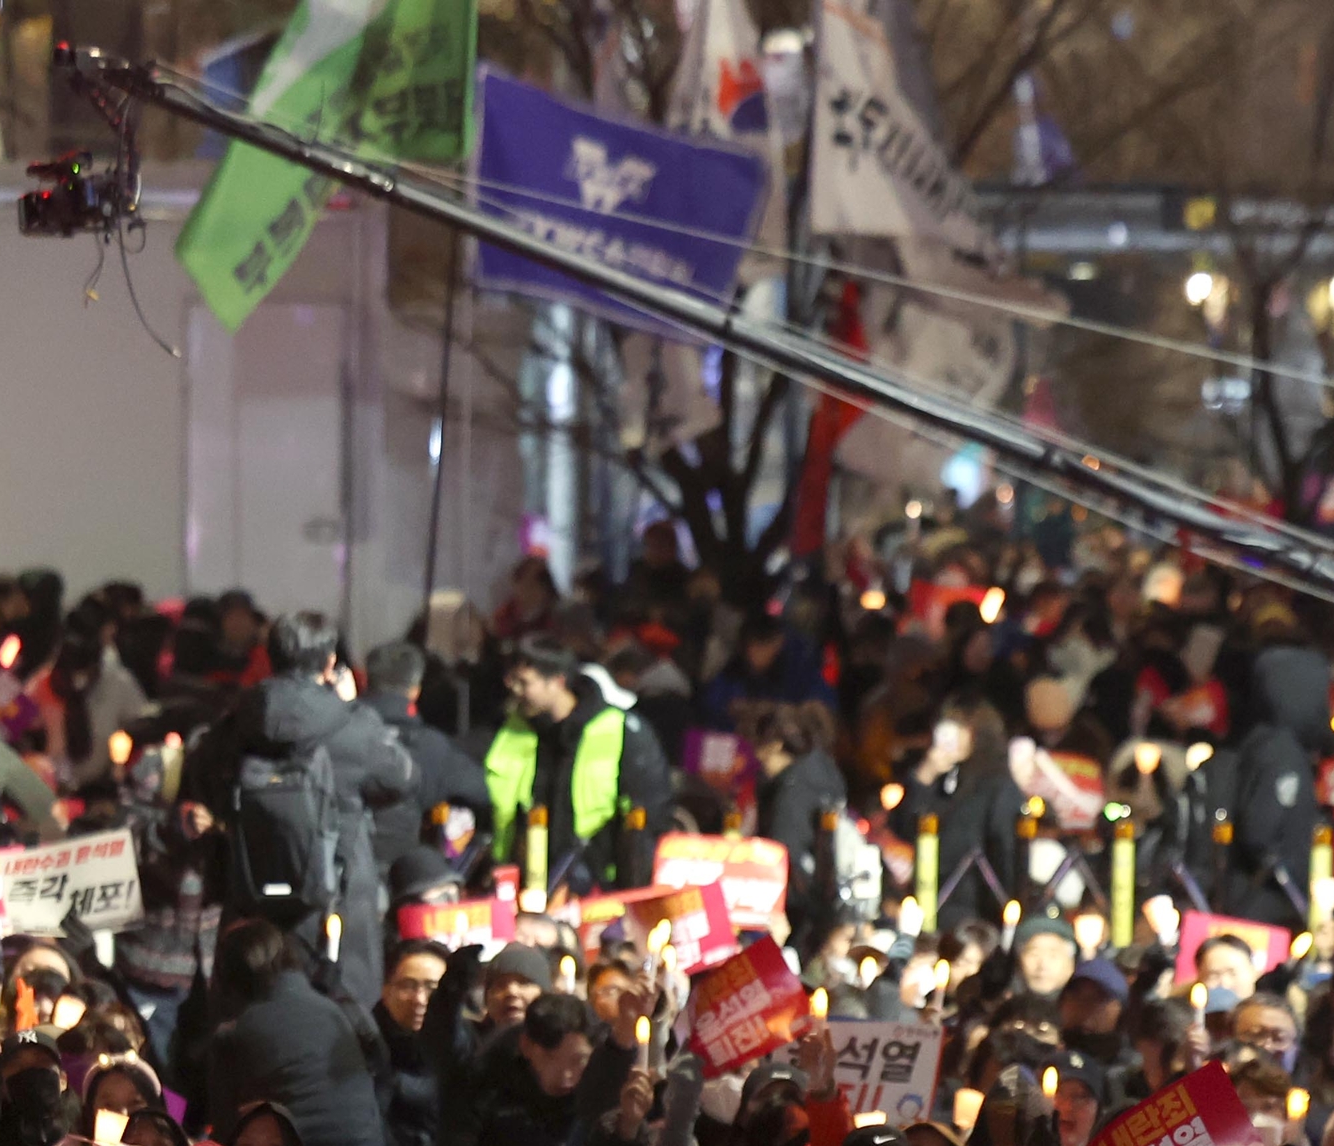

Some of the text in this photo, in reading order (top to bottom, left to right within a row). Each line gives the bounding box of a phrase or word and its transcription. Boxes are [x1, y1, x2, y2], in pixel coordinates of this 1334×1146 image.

[8, 874, 69, 903] 즉각
[69, 879, 134, 917] 체포!
[695, 979, 772, 1041] 윤석열
